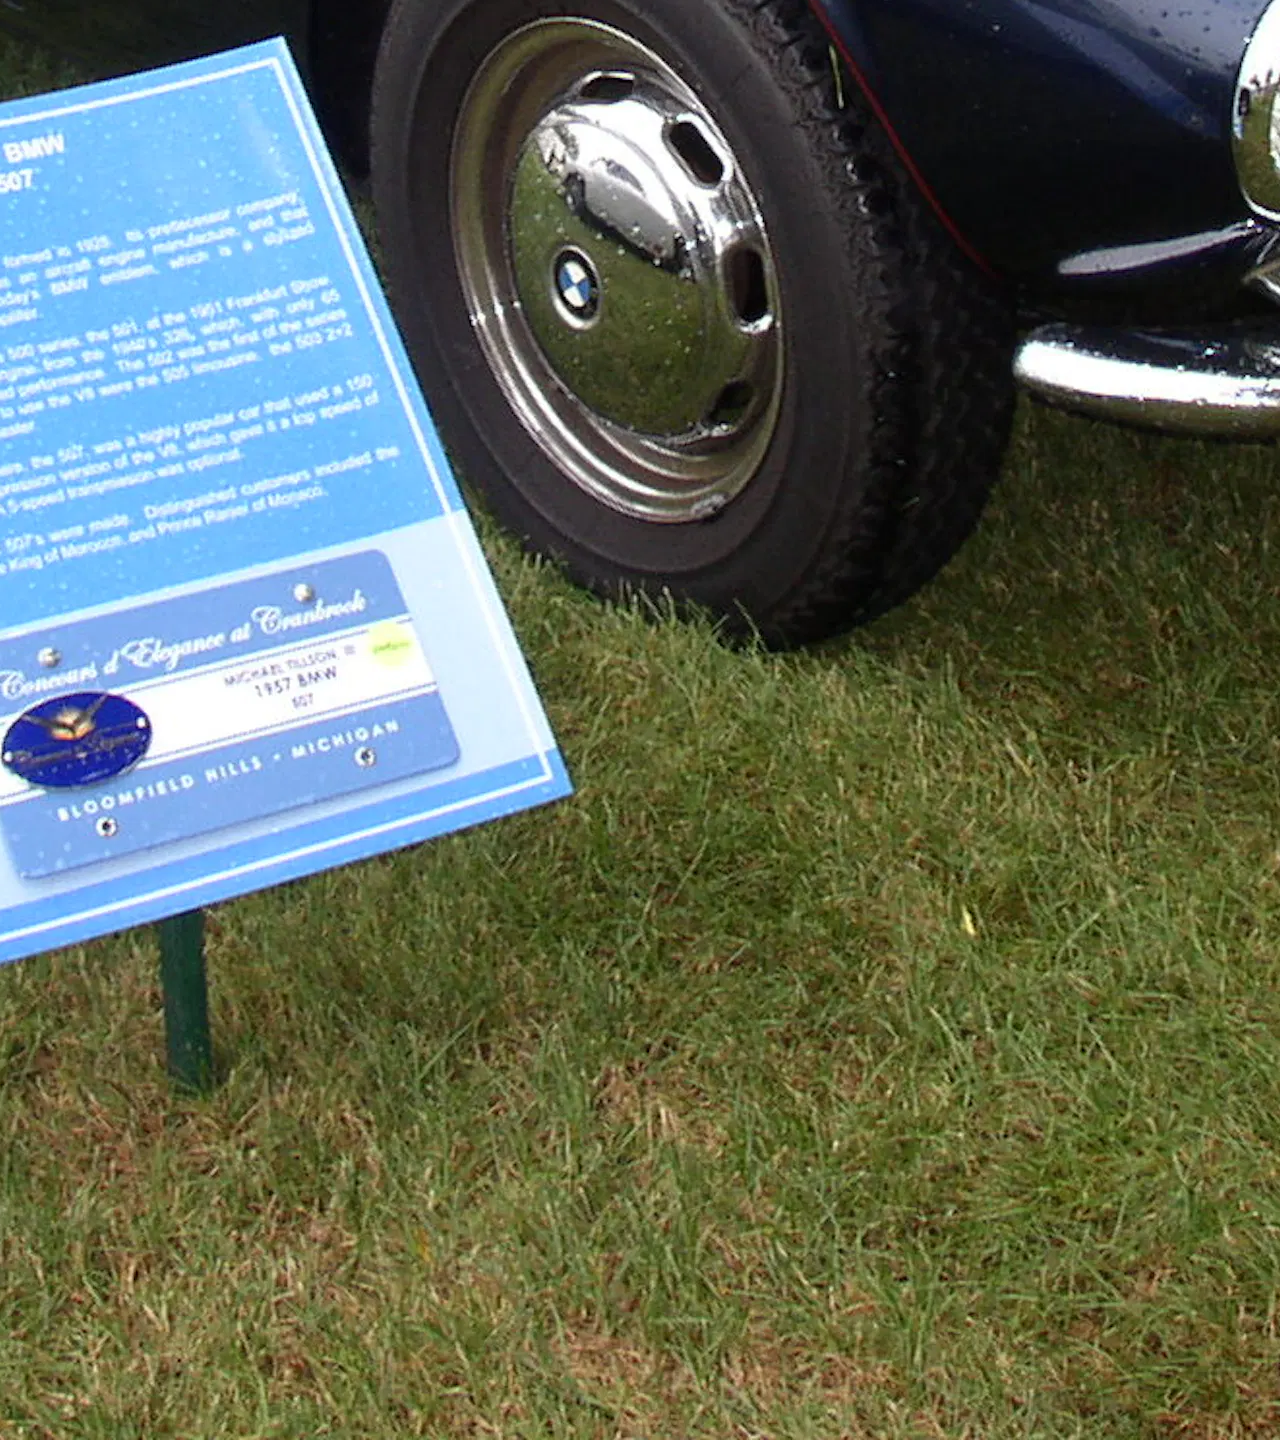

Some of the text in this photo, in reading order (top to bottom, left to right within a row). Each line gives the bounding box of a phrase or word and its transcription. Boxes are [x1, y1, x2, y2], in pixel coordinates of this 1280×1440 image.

[3, 133, 65, 164] BMW
[230, 621, 251, 644] at
[250, 589, 367, 635] Cranbrook
[224, 663, 283, 687] MICHAEL
[254, 665, 338, 699] 1957 BMW
[291, 692, 315, 710] 507
[56, 719, 401, 823] BLOOMFIELD HILLS MICHIGAN
